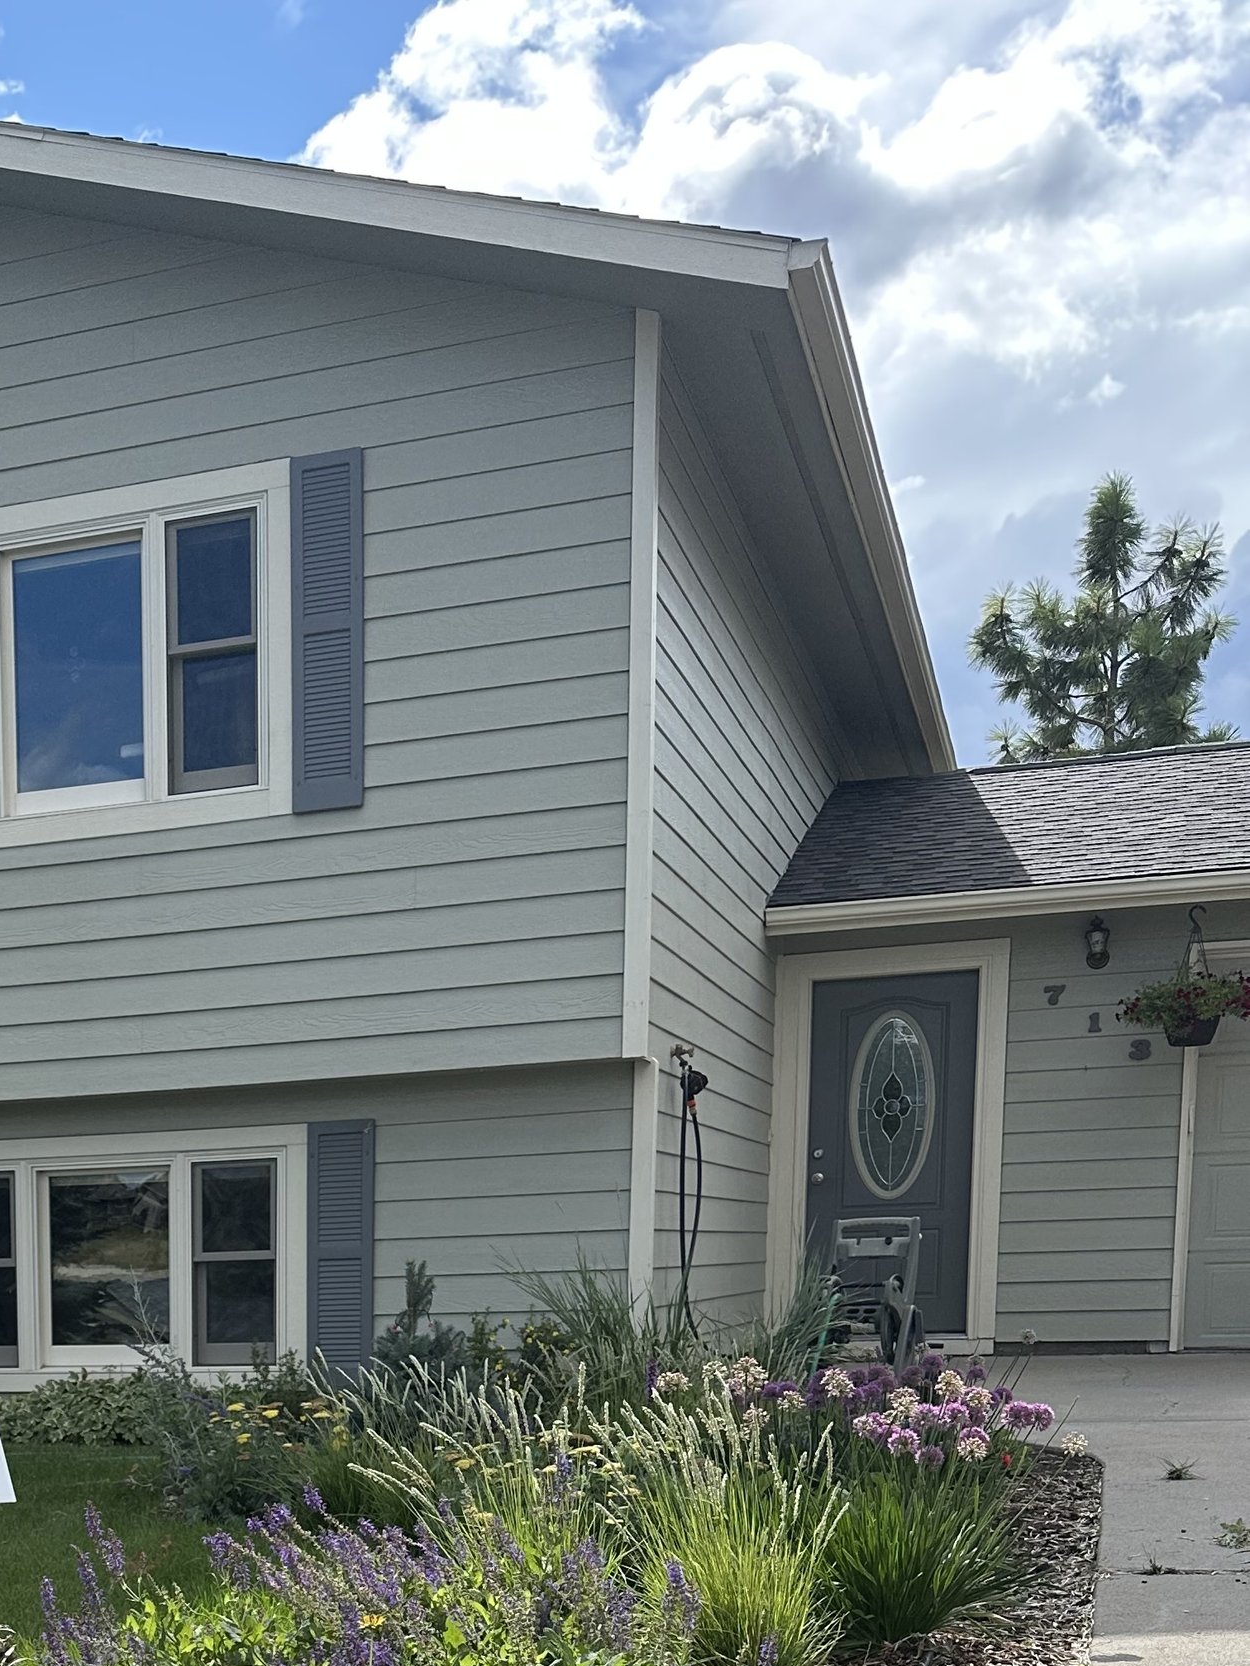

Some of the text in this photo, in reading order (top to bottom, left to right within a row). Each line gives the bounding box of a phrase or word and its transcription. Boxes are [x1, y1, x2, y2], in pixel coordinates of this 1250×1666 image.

[1043, 984, 1152, 1061] 7 1 3
